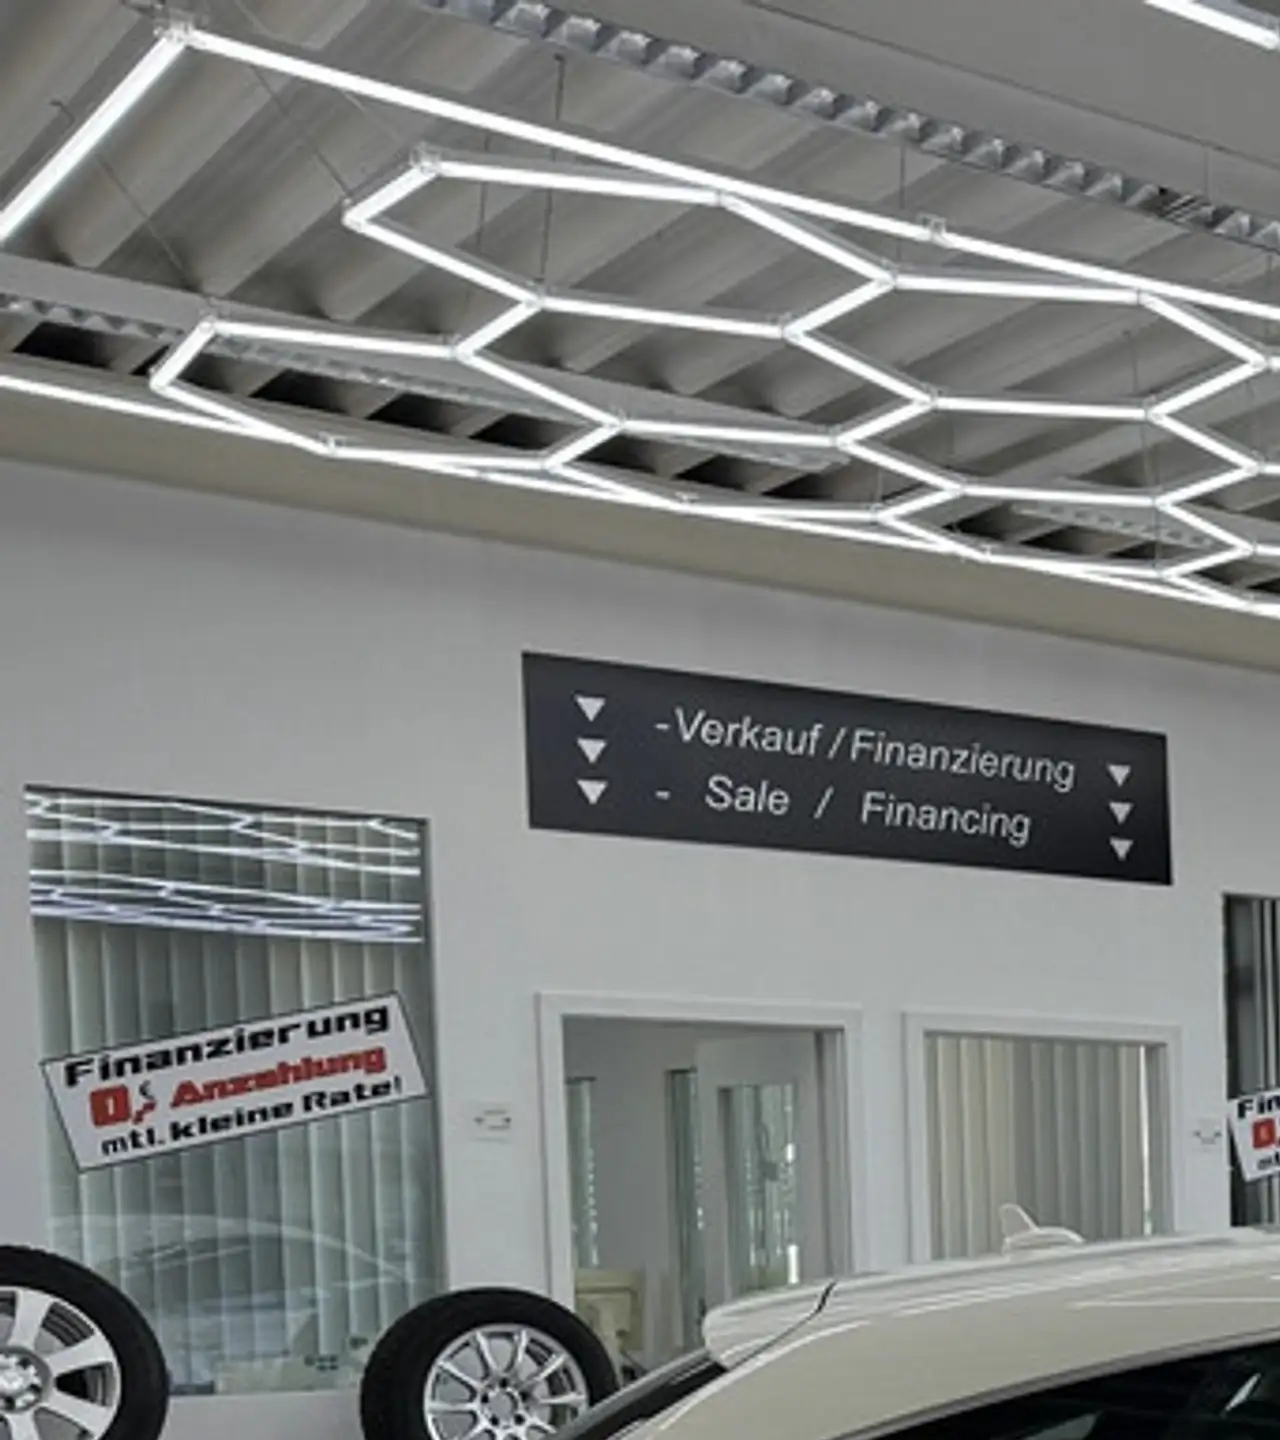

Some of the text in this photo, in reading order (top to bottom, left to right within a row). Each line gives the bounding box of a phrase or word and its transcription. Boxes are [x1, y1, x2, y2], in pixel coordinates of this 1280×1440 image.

[850, 729, 1077, 792] Finanzierung
[705, 776, 789, 815] Sale
[862, 791, 1031, 847] Financing
[64, 1004, 390, 1088] Finanzierung
[169, 1046, 387, 1108] Anzahlung
[171, 1100, 294, 1141] kleine
[303, 1075, 401, 1111] Rate!
